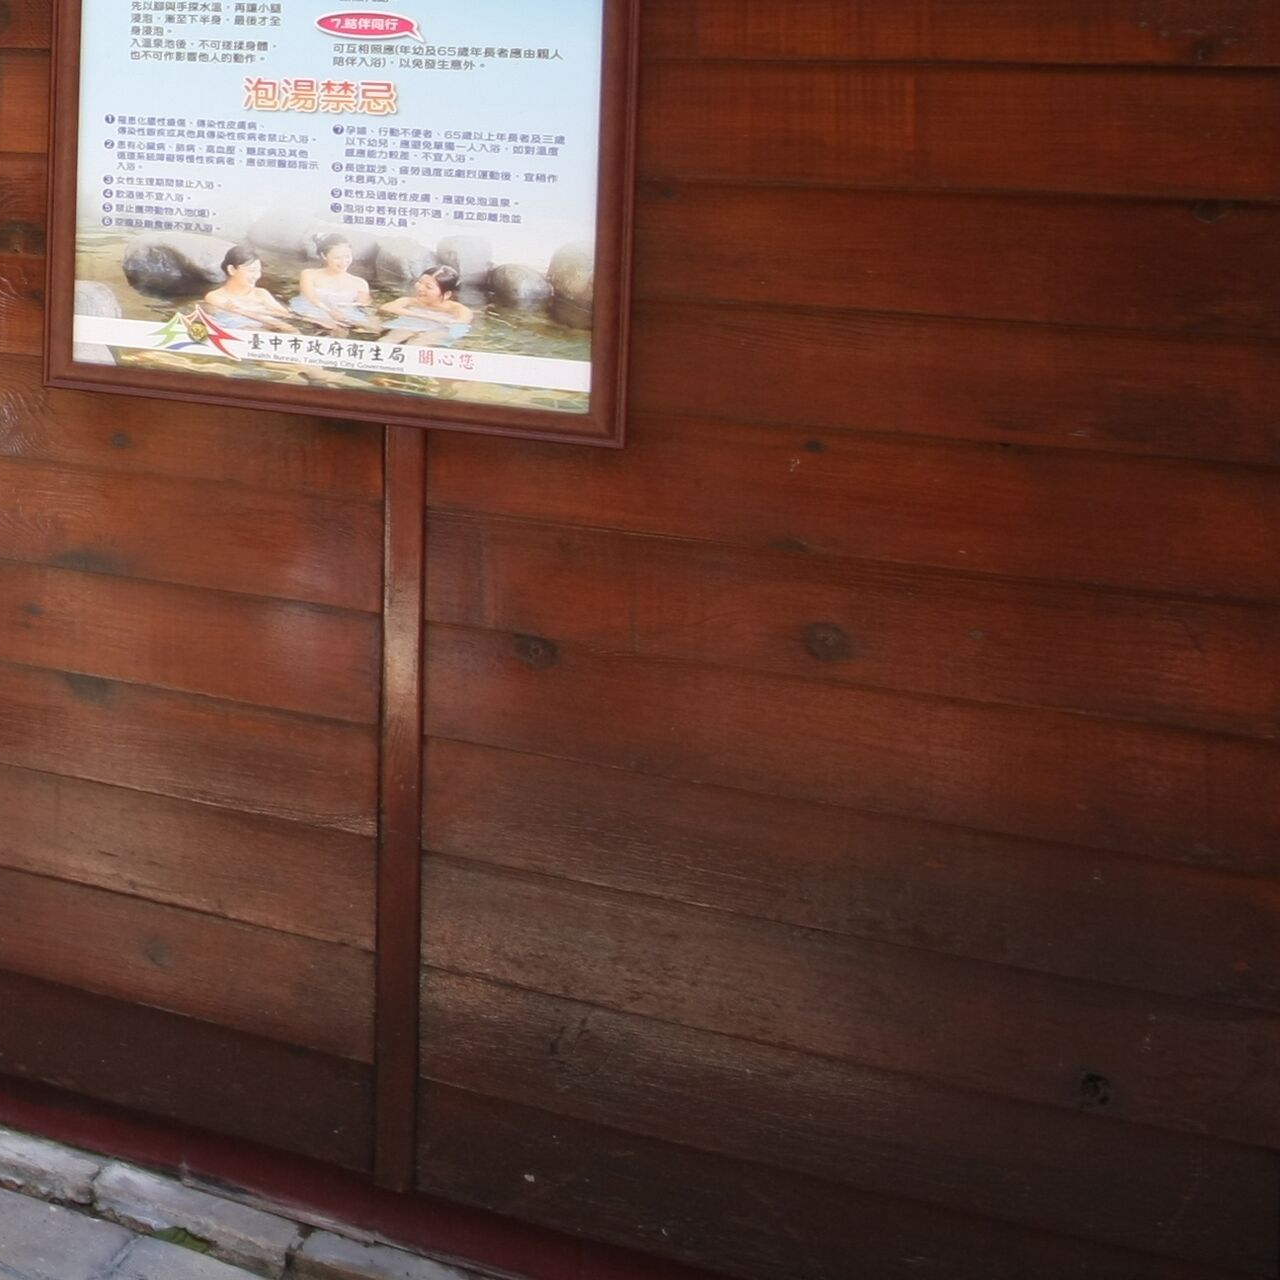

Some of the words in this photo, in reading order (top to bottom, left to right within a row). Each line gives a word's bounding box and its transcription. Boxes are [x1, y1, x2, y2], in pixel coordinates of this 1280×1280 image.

[242, 76, 400, 116] 泡湯禁忌
[247, 333, 407, 364] 臺中市政府衛生局
[418, 349, 475, 370] 關心您
